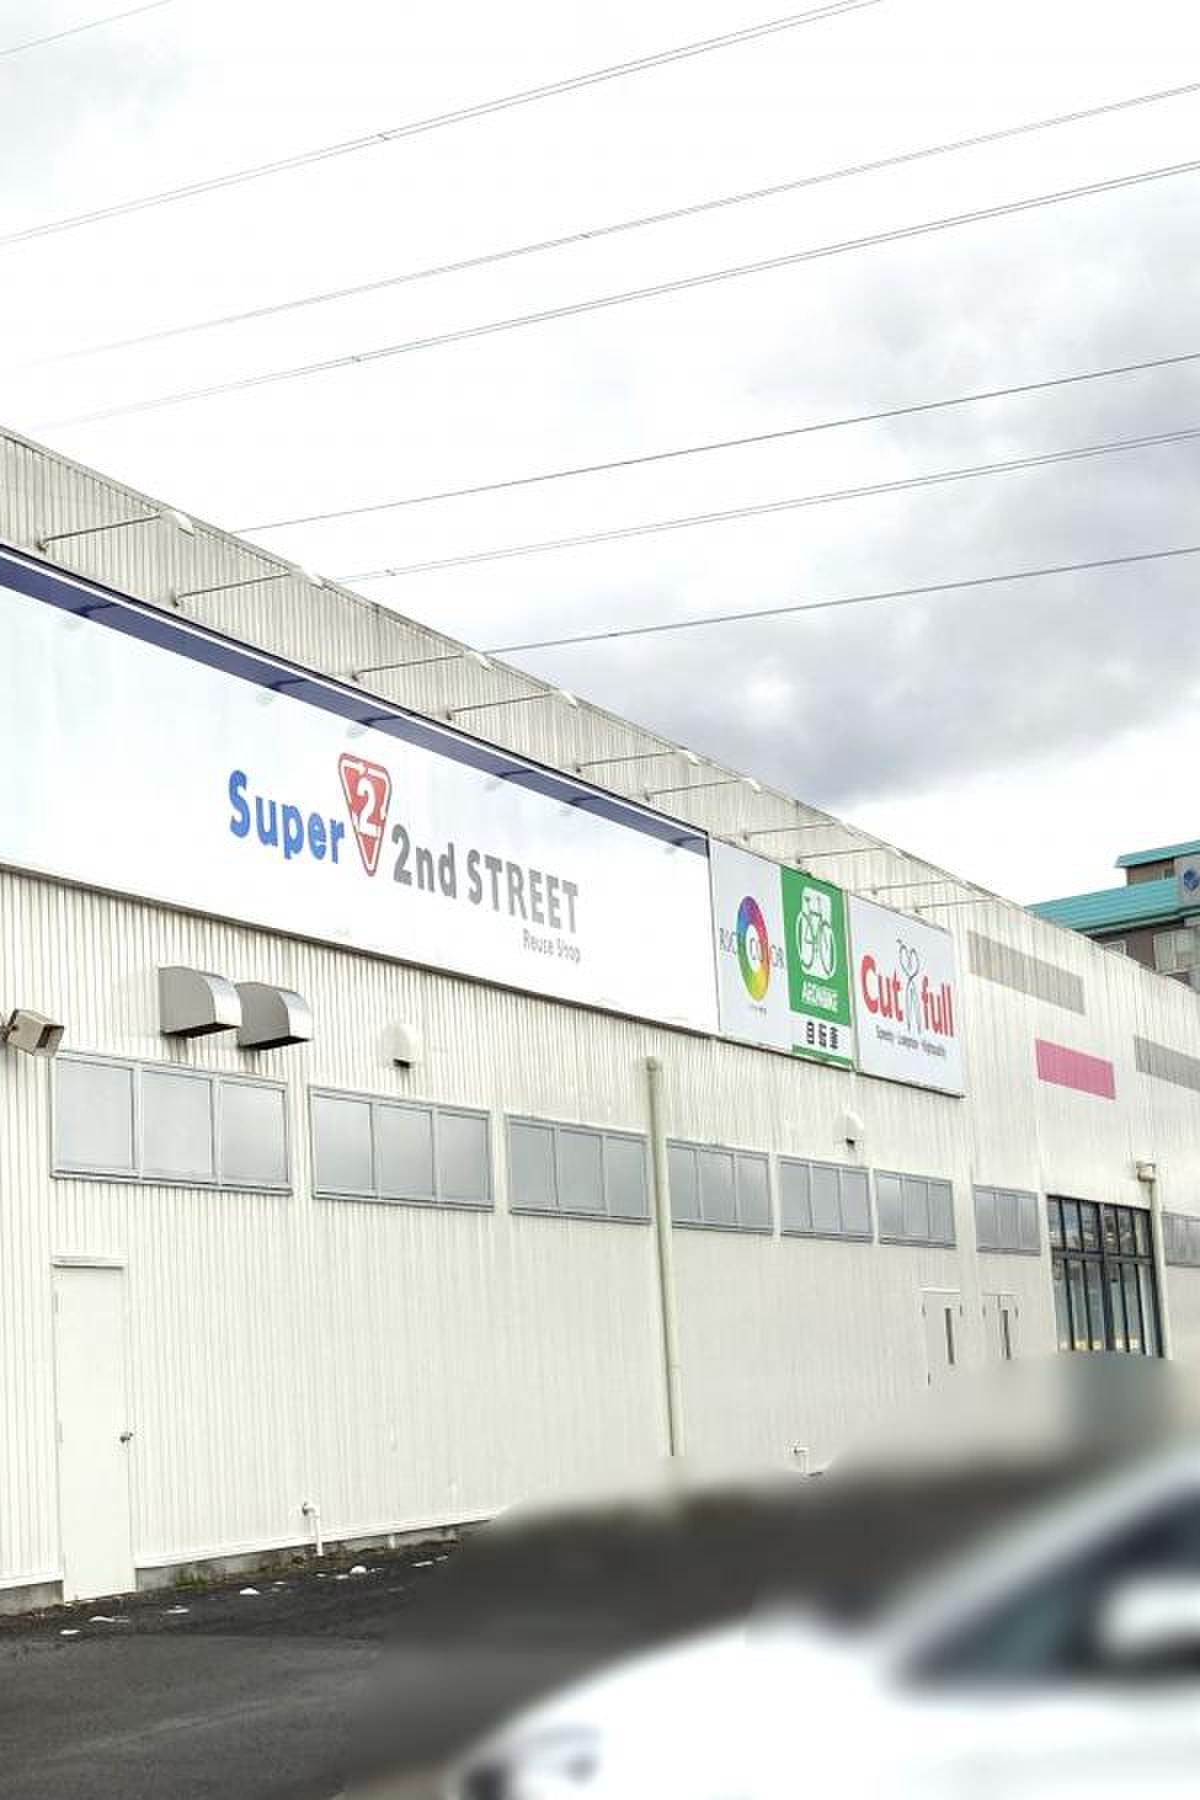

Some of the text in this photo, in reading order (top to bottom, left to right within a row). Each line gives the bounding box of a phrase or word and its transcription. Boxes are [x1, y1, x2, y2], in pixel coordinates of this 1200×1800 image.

[228, 769, 346, 864] Super
[391, 823, 458, 899] 2nd
[467, 848, 579, 933] STREET
[861, 954, 904, 1022] Cut
[921, 975, 954, 1037] full
